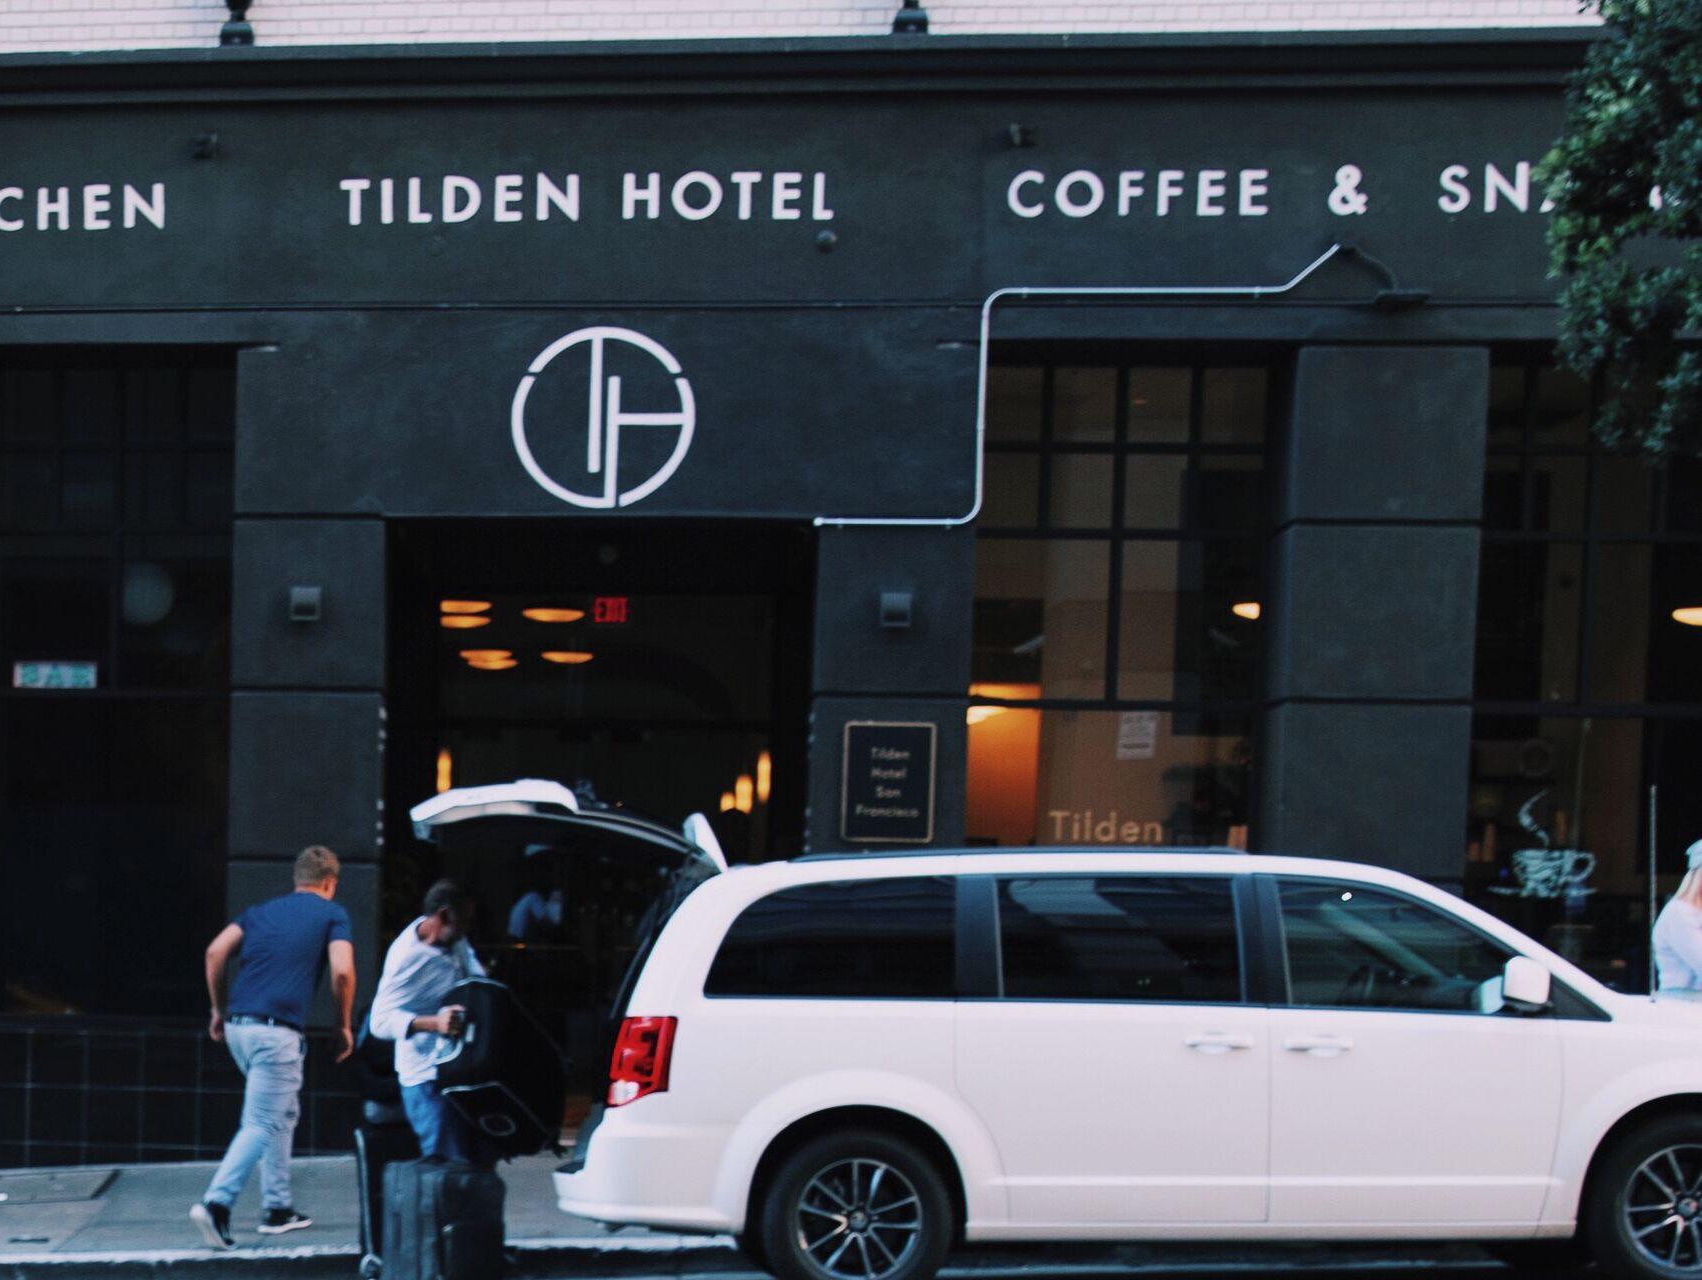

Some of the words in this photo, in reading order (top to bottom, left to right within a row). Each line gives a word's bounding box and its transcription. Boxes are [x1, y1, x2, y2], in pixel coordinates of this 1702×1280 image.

[339, 172, 581, 226] TILDEN
[622, 170, 835, 221] HOTEL
[1007, 168, 1269, 219] COFFEE
[1327, 163, 1369, 217] &
[871, 747, 911, 760] Tilden
[1048, 809, 1164, 843] Tilden
